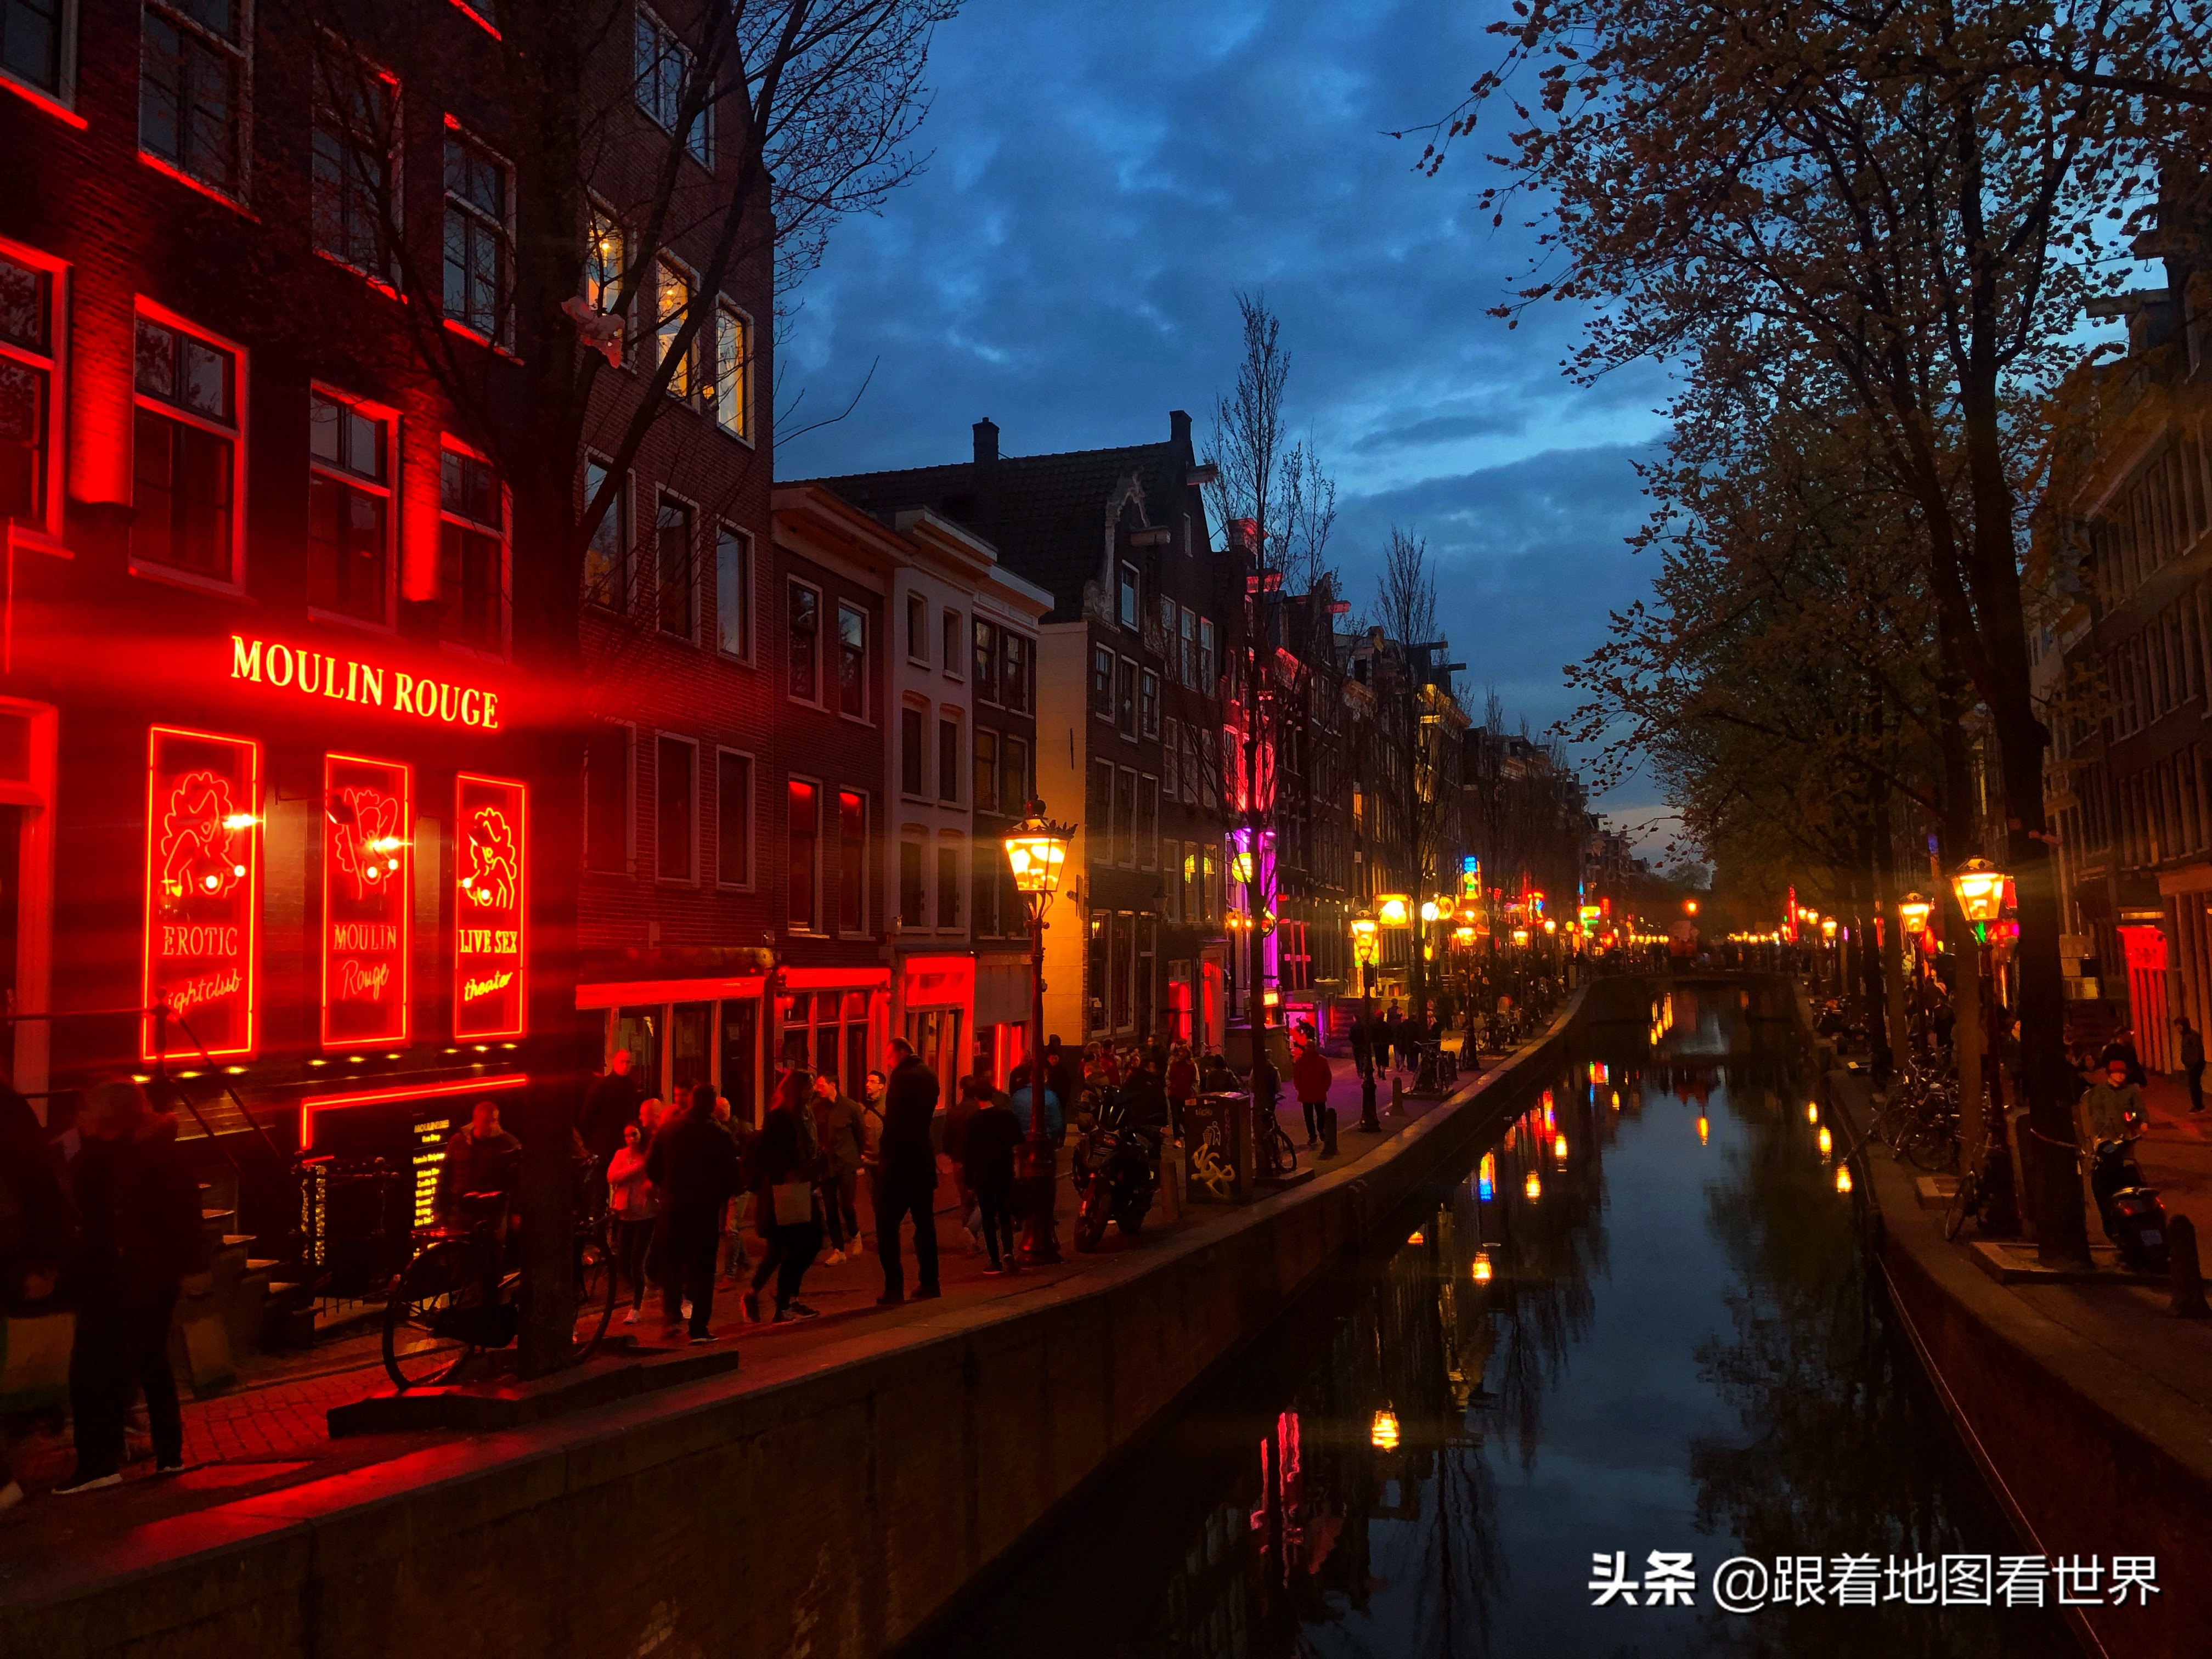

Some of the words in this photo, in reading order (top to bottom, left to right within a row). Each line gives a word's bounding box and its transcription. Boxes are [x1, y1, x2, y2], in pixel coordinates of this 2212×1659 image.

[230, 635, 384, 706] MOULIN
[393, 672, 499, 729] ROUGE
[162, 926, 238, 956] EROTIC
[334, 924, 397, 951] MOULIN
[459, 929, 492, 953] LIVE
[494, 930, 518, 953] SEX
[167, 967, 243, 1014] ightclub
[341, 960, 390, 1001] Rouge
[464, 970, 514, 1002] theater
